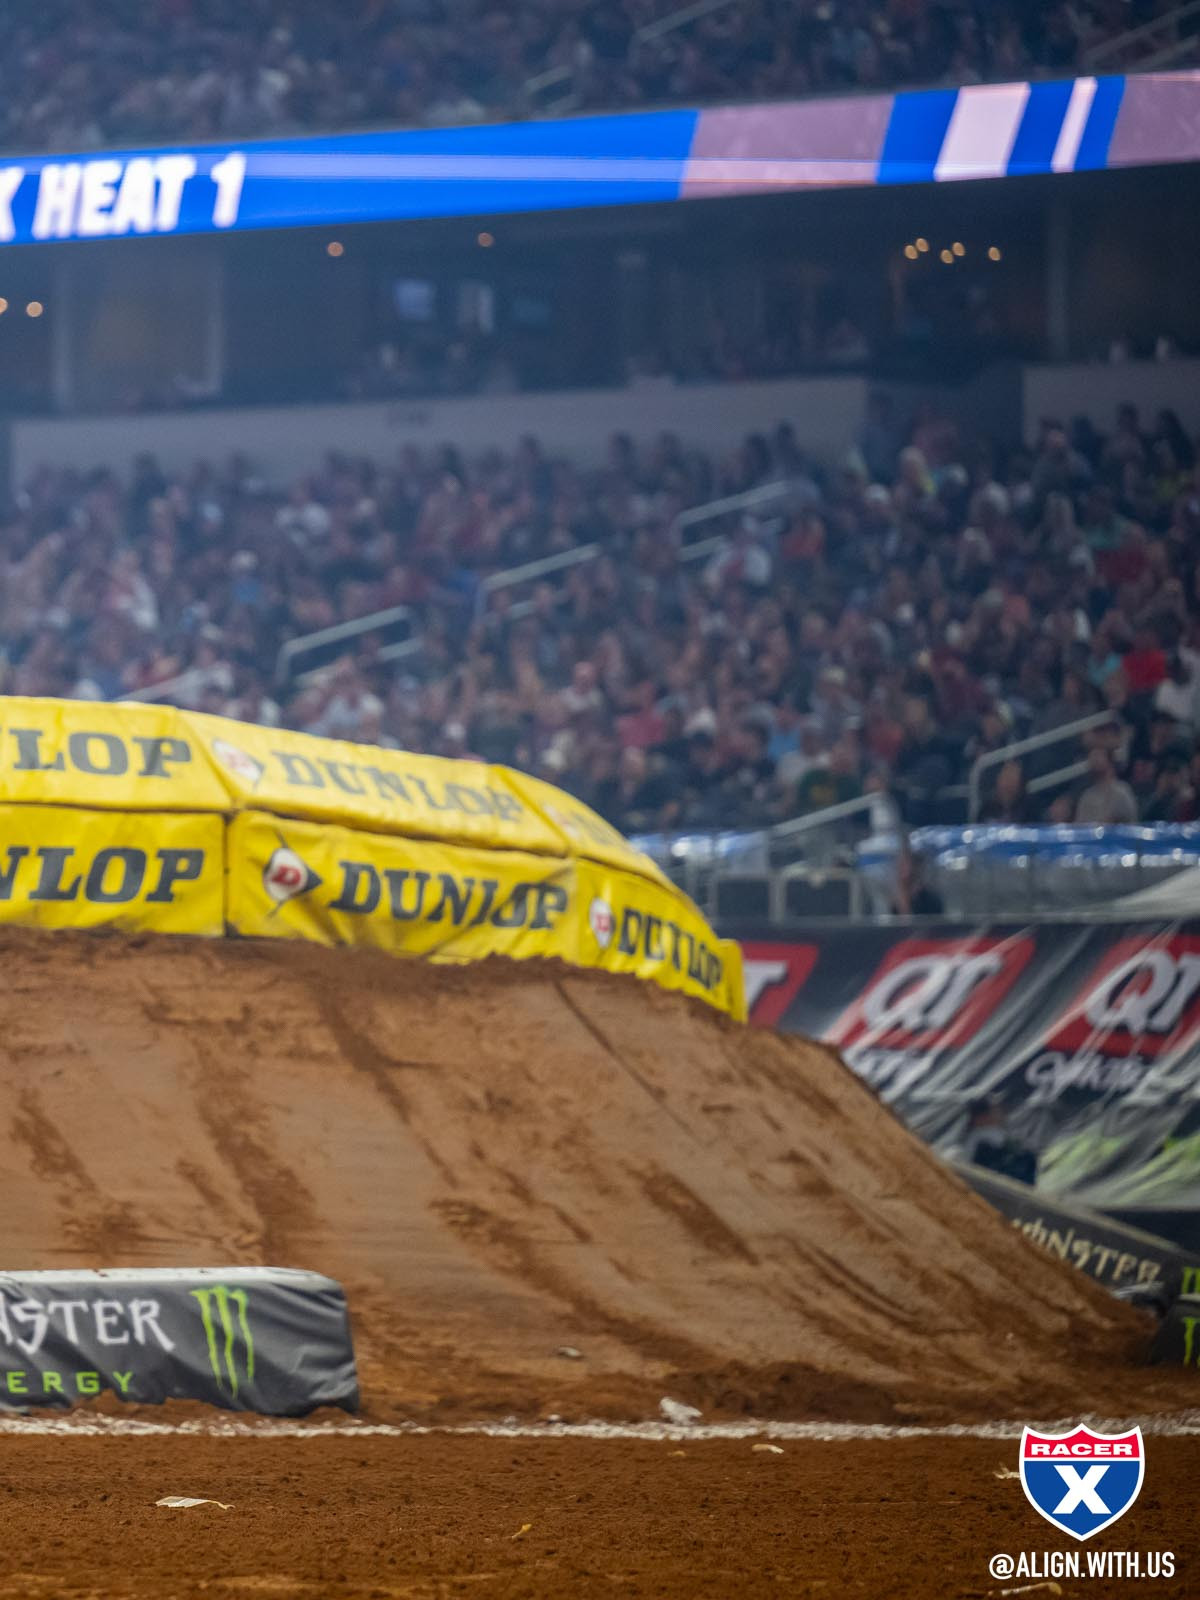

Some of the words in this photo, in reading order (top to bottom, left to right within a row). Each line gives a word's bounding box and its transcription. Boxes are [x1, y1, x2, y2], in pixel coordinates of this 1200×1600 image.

[32, 155, 196, 239] HEAT
[211, 152, 247, 228] 1
[272, 751, 523, 824] DUNLOP
[330, 861, 568, 930] DUNLOP
